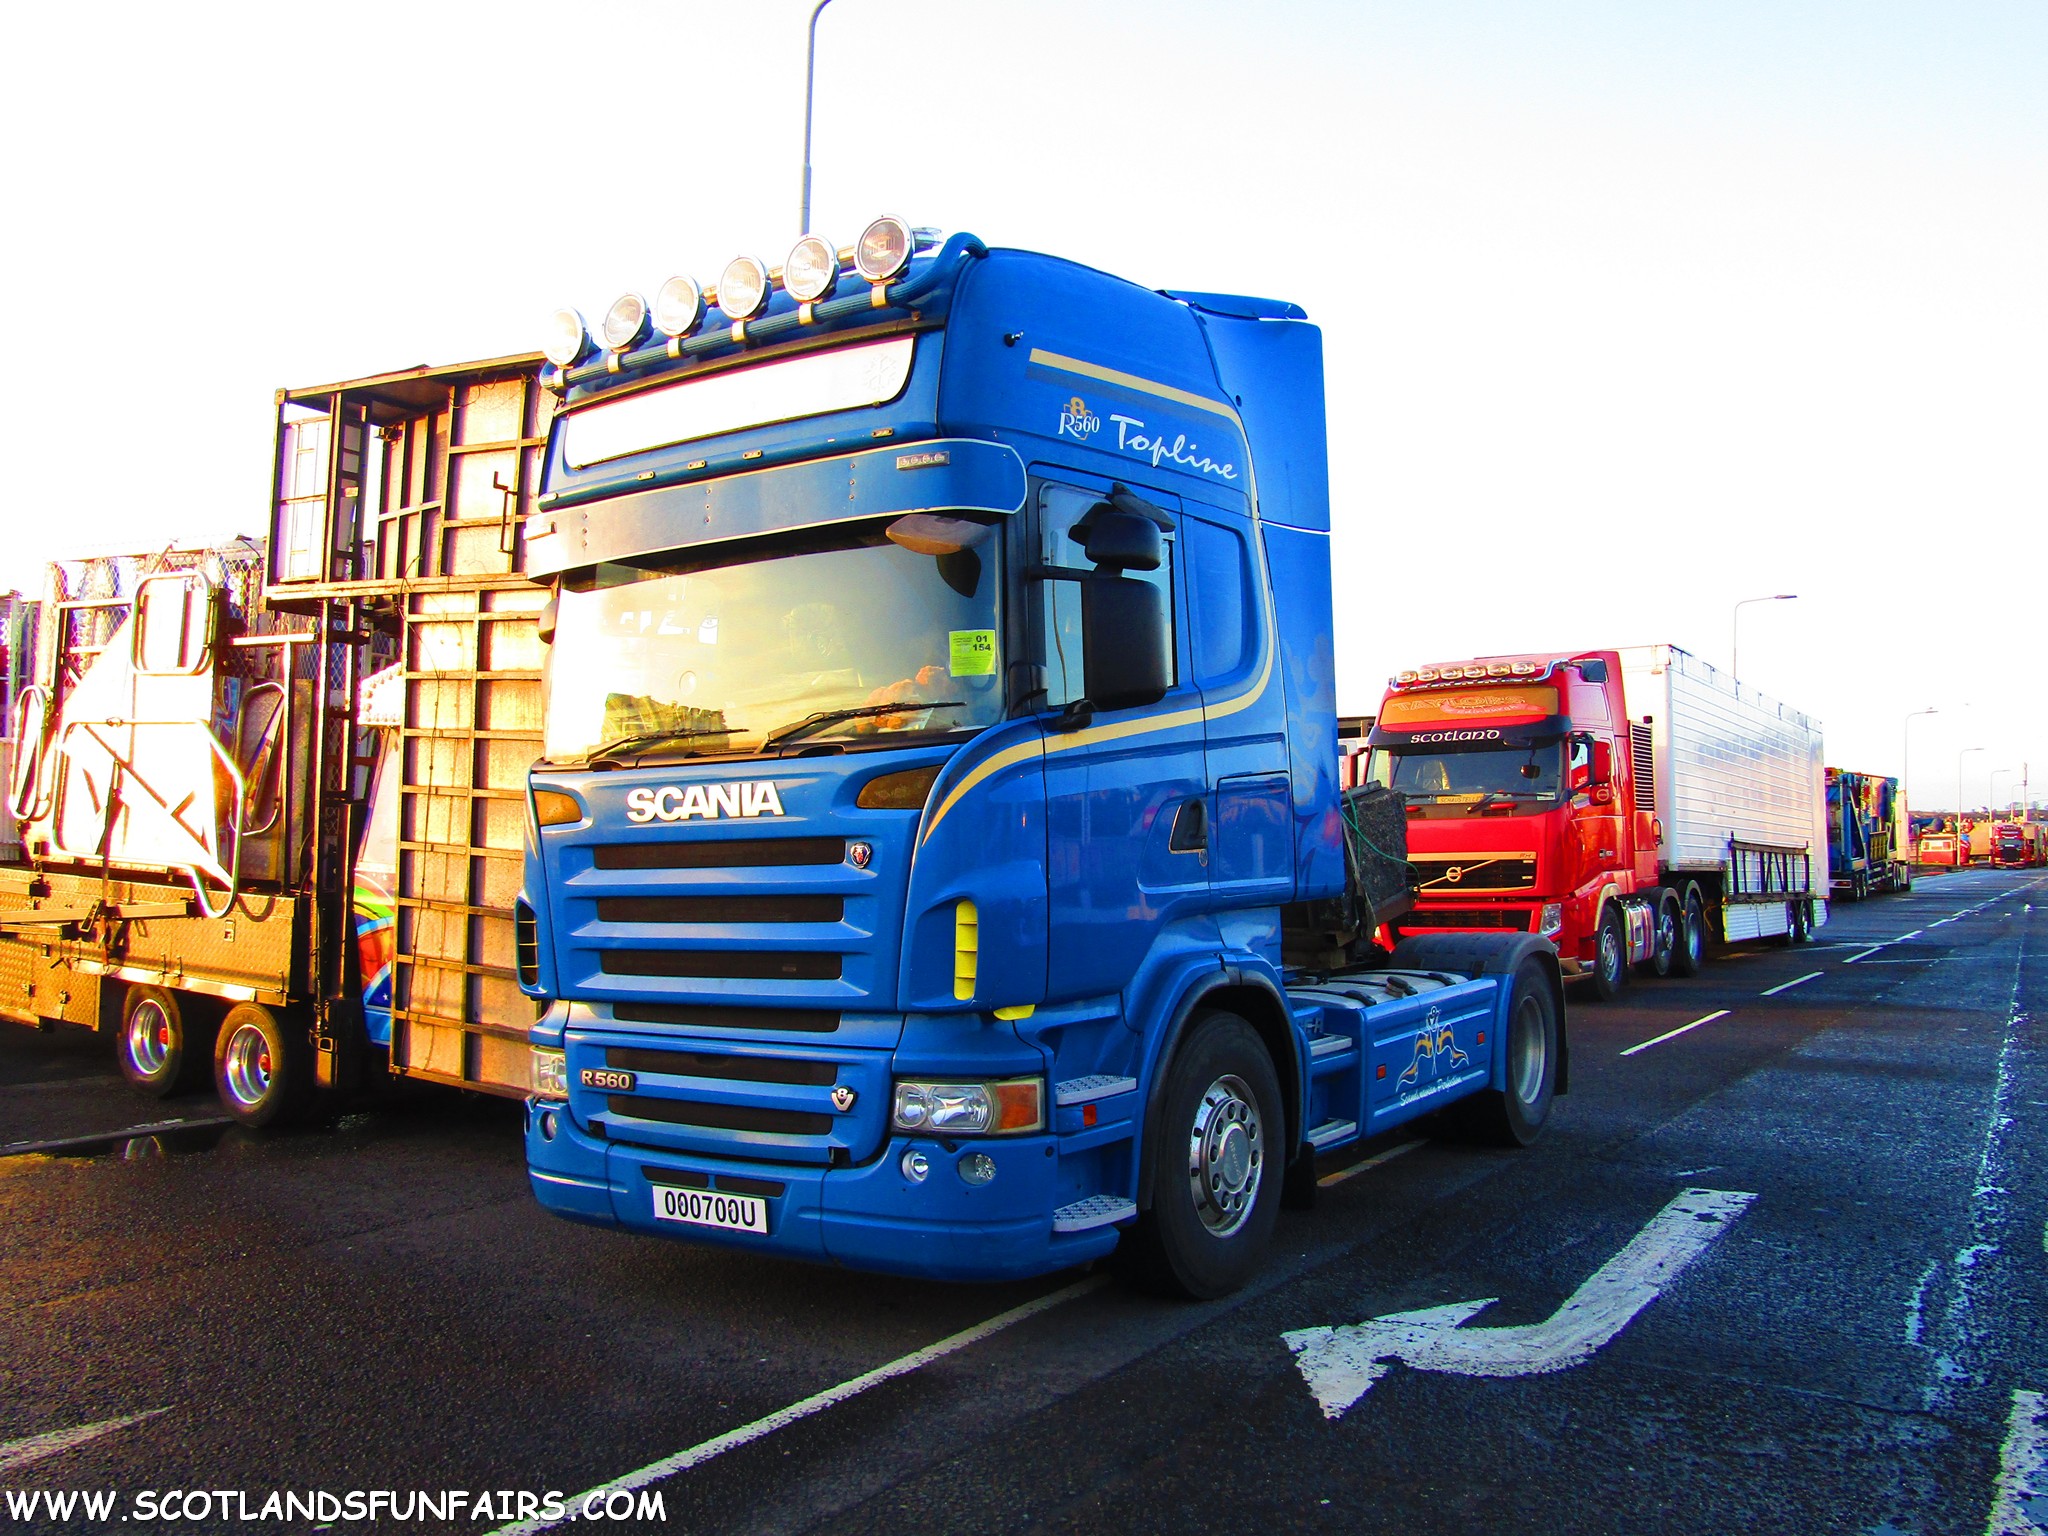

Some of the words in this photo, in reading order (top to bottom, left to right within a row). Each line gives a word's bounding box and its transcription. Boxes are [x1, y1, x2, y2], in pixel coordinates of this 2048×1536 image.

[1058, 412, 1100, 438] R560
[1109, 413, 1238, 480] Topline
[973, 643, 991, 652] 154
[976, 635, 988, 643] 01
[626, 781, 785, 823] SCANIA
